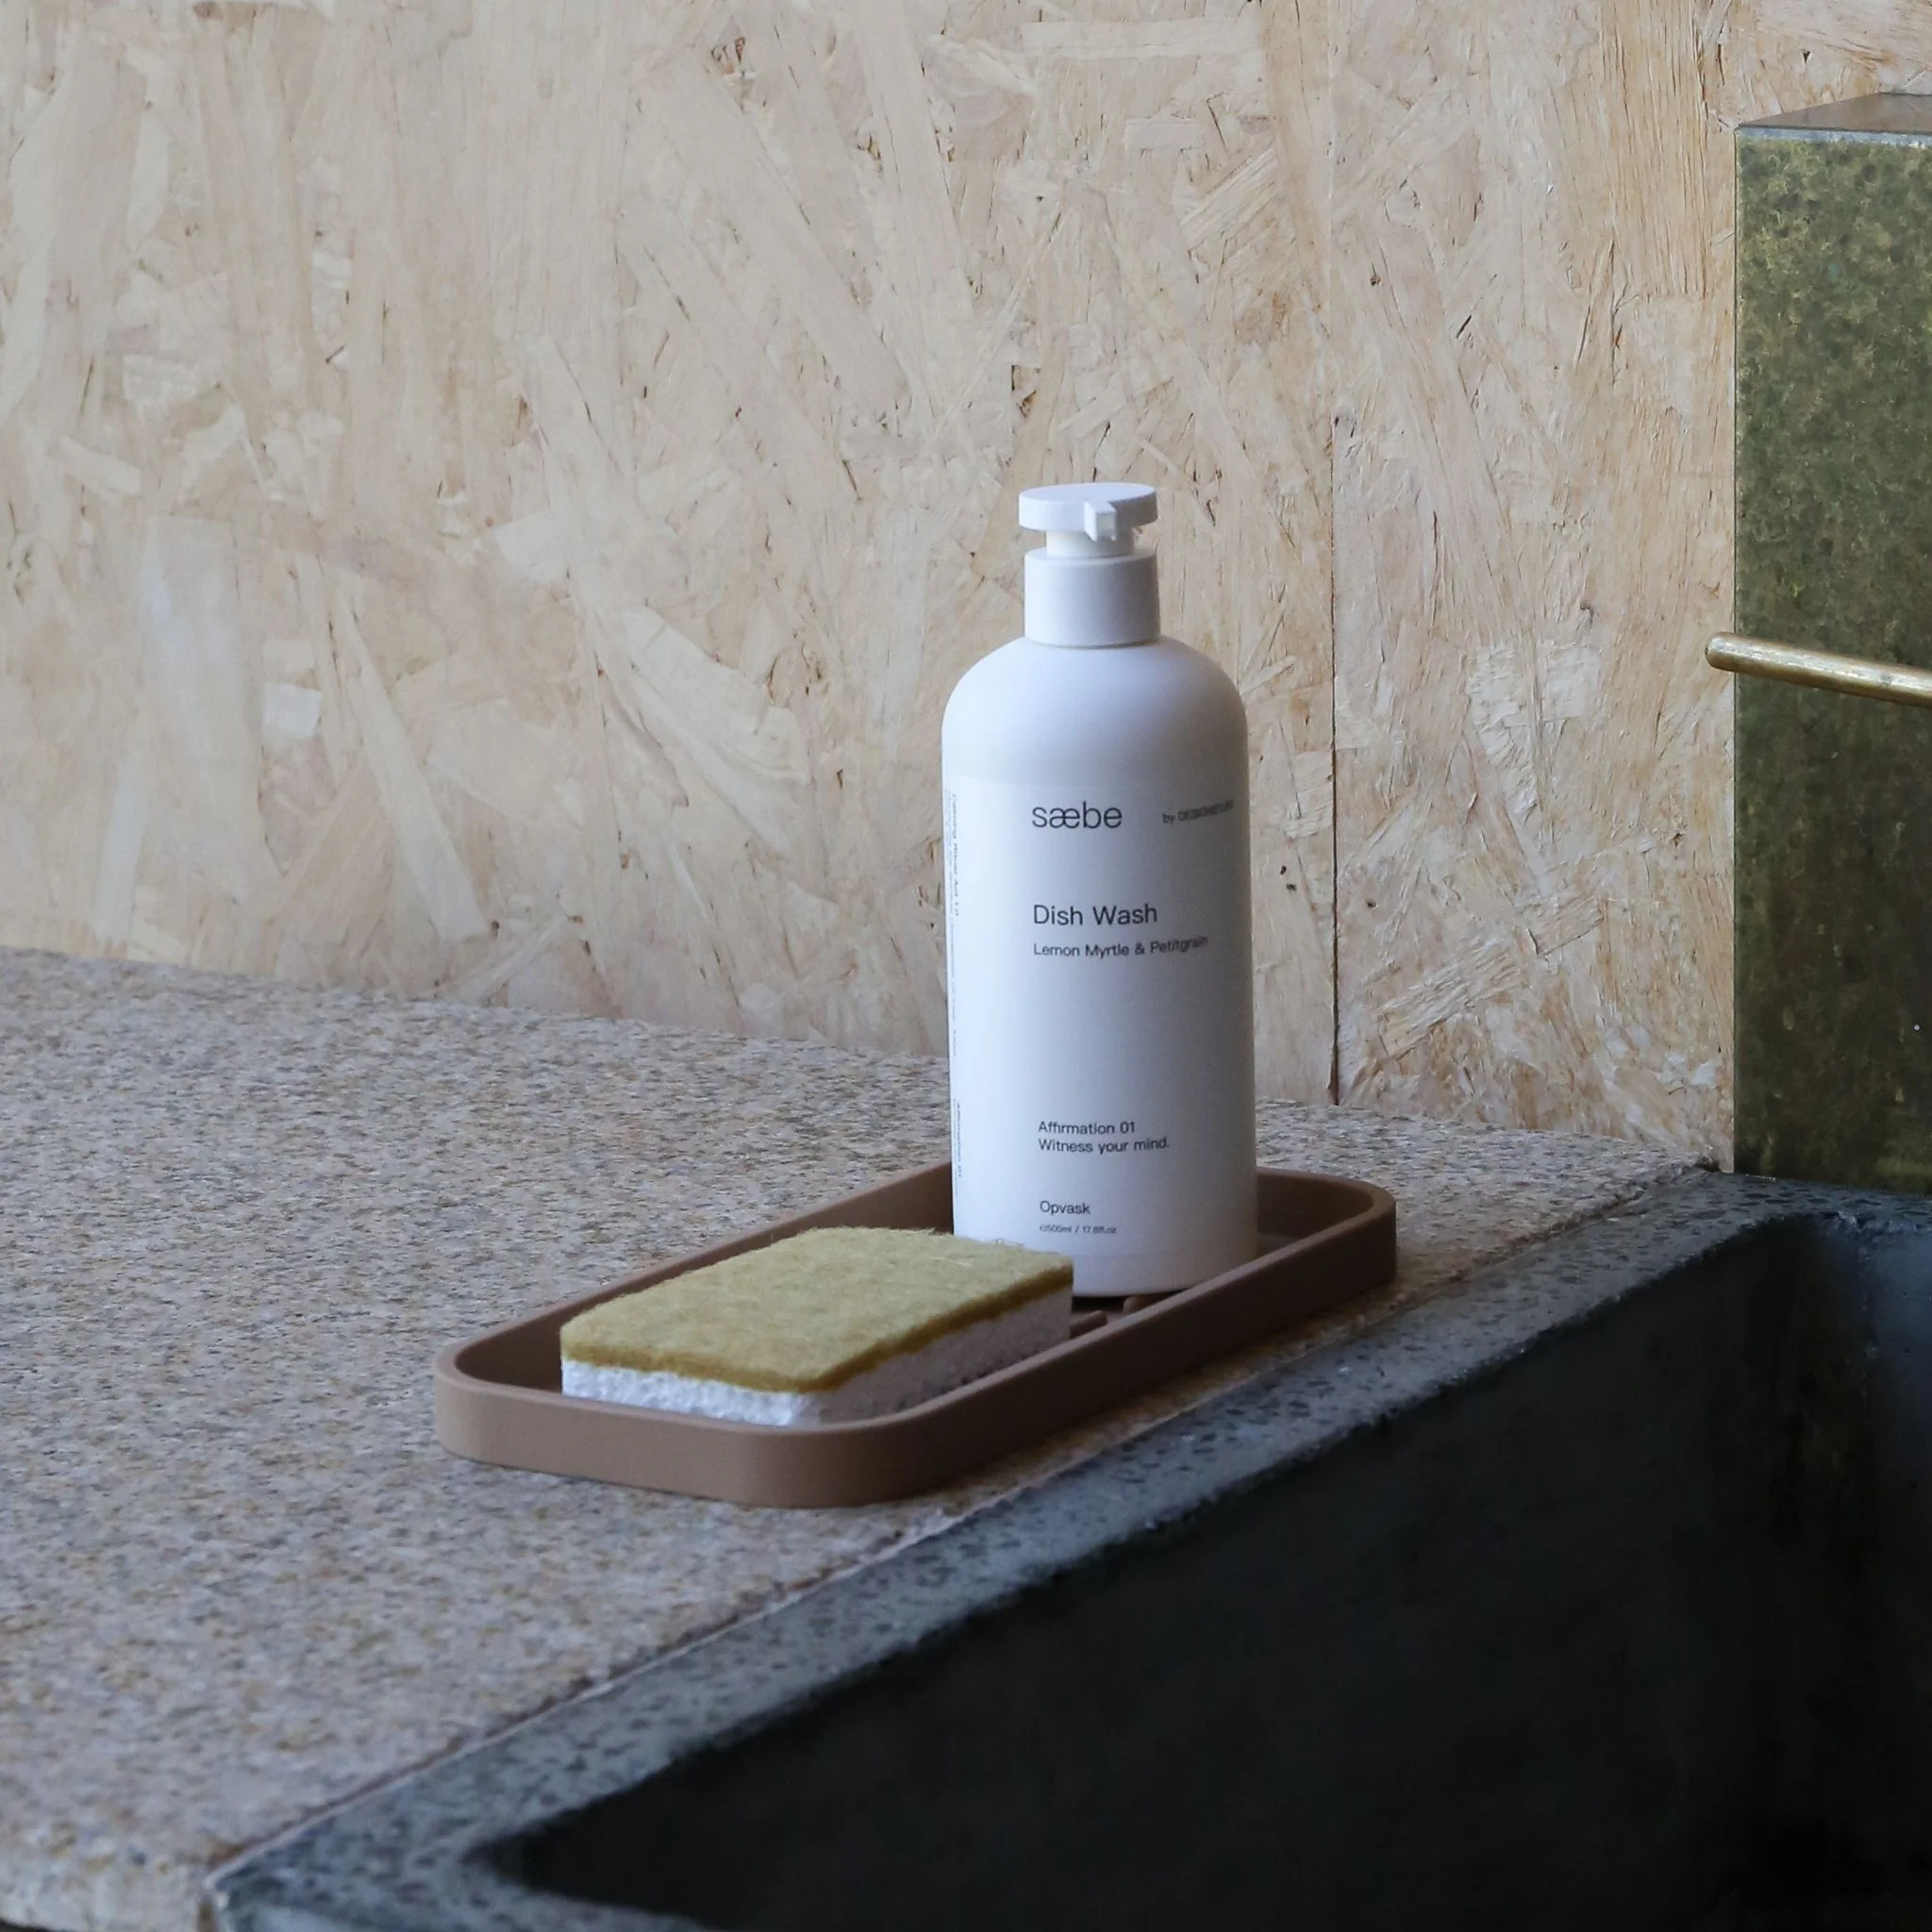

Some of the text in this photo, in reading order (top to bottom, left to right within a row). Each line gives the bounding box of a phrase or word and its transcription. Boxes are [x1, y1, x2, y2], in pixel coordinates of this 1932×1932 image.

[1032, 801, 1123, 828] sæbe
[1034, 903, 1158, 925] Dish Wash
[1034, 943, 1080, 957] Lemon
[1085, 943, 1130, 959] Myrtle
[1134, 943, 1145, 956] &
[1038, 1121, 1135, 1135] Affirmation 01
[1038, 1136, 1170, 1155] Witness your mind.
[1040, 1200, 1091, 1215] Opvask
